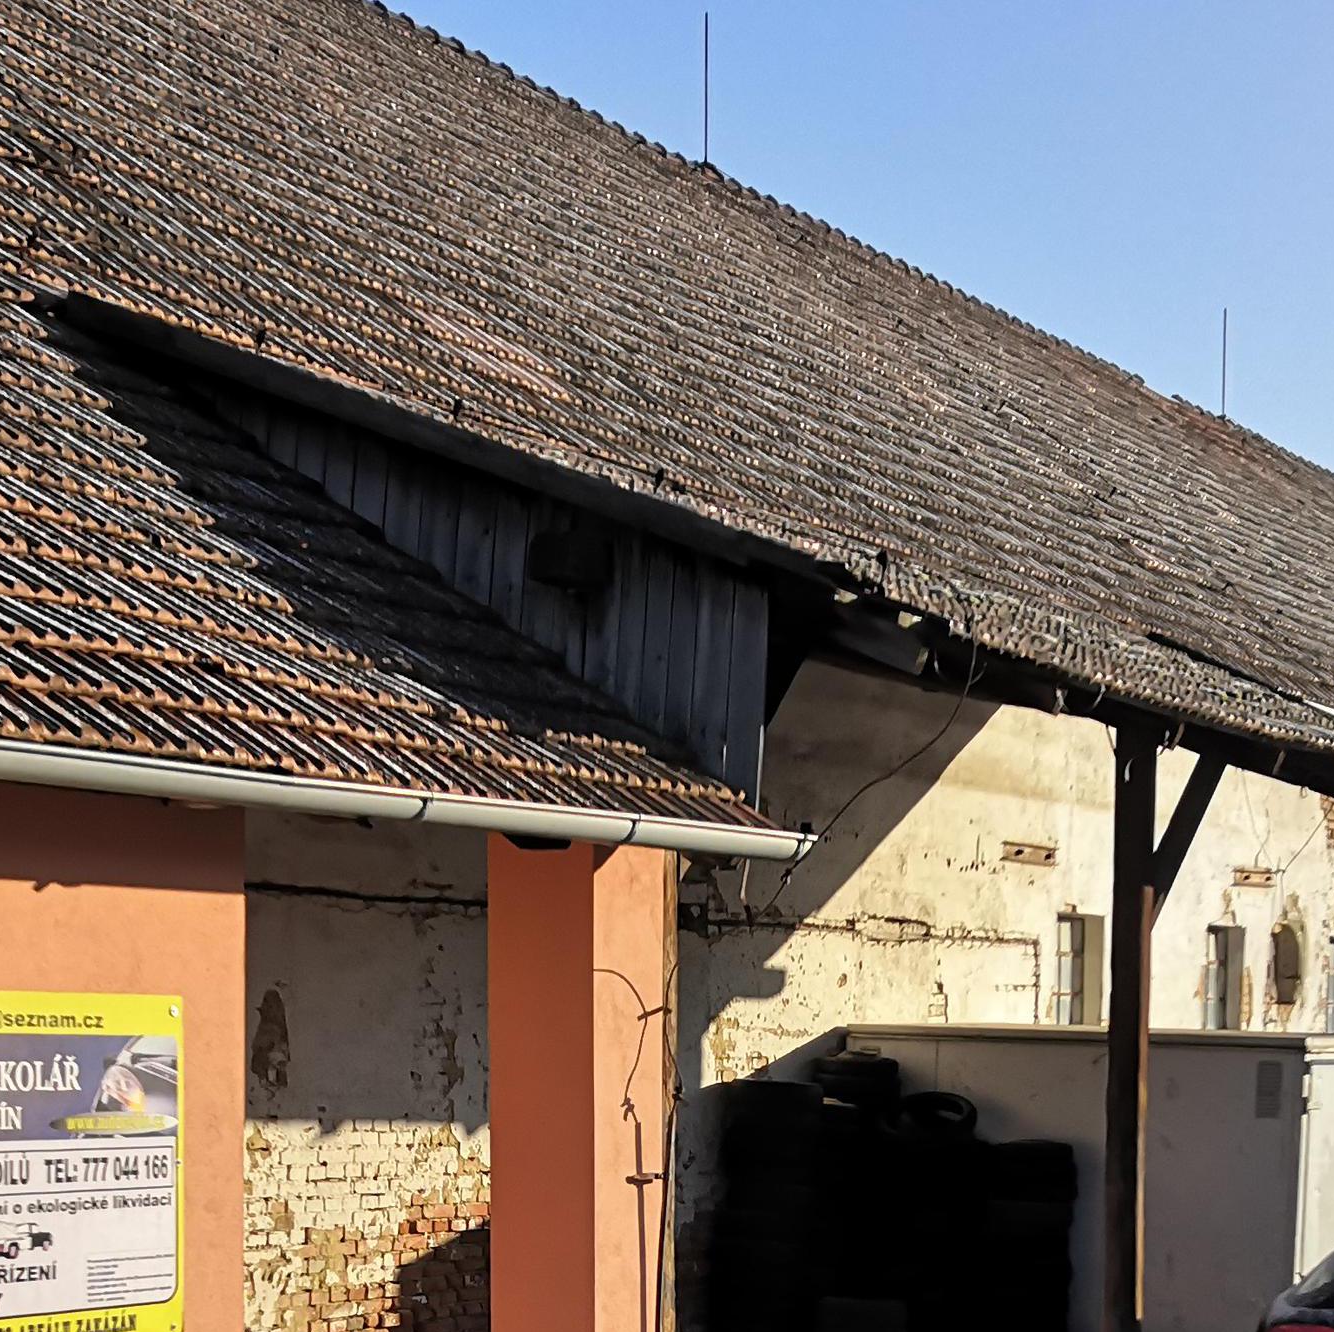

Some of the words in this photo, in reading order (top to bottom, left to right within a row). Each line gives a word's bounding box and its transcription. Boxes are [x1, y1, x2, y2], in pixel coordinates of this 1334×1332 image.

[44, 1158, 78, 1184] TEL:
[82, 1156, 109, 1182] 777
[113, 1155, 139, 1181] 044
[144, 1154, 169, 1179] 166
[12, 1203, 23, 1215] o
[27, 1196, 109, 1215] ekologické
[113, 1192, 172, 1209] likvidaci
